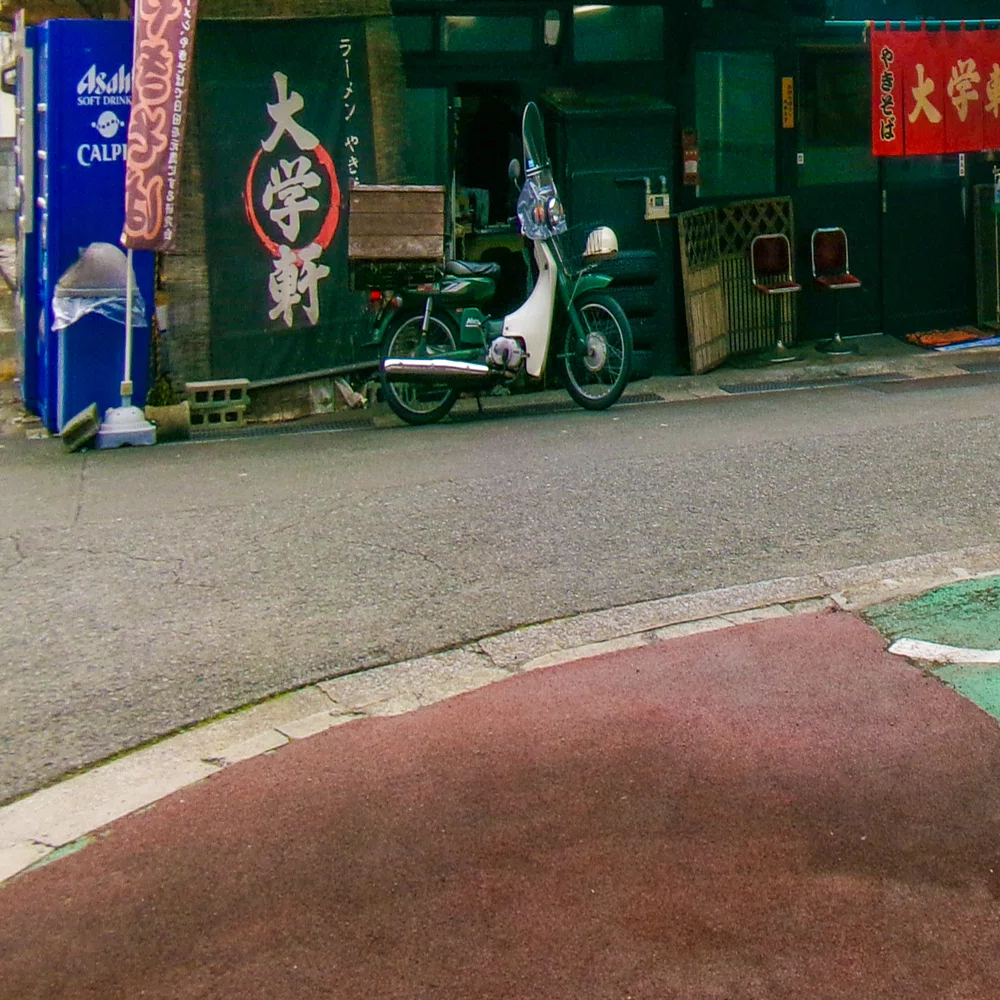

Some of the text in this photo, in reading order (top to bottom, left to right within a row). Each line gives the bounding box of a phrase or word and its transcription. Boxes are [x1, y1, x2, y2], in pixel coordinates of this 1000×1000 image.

[77, 64, 132, 95] Asah
[77, 96, 132, 106] SOFT DRINK
[339, 38, 356, 121] ラーメン
[880, 46, 896, 142] やきそば
[77, 144, 129, 167] CALPI
[344, 135, 360, 186] やき
[261, 71, 331, 328] 大学軒
